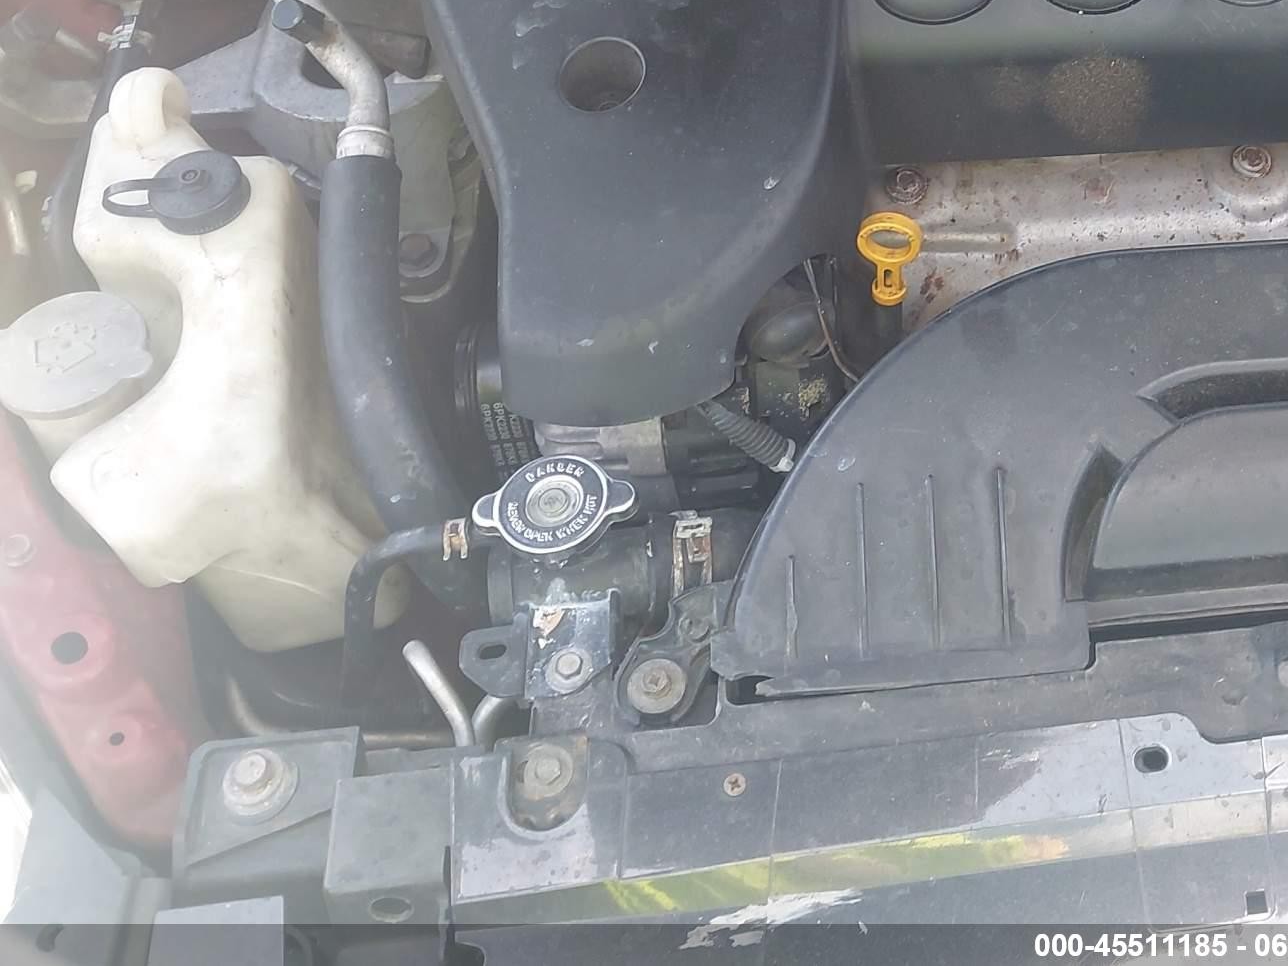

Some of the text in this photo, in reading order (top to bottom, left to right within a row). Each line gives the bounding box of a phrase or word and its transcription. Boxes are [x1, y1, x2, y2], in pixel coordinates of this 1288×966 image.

[525, 462, 585, 483] DANGER
[507, 501, 527, 534] NEVER
[523, 529, 554, 542] OPEN
[555, 513, 590, 540] WHEN
